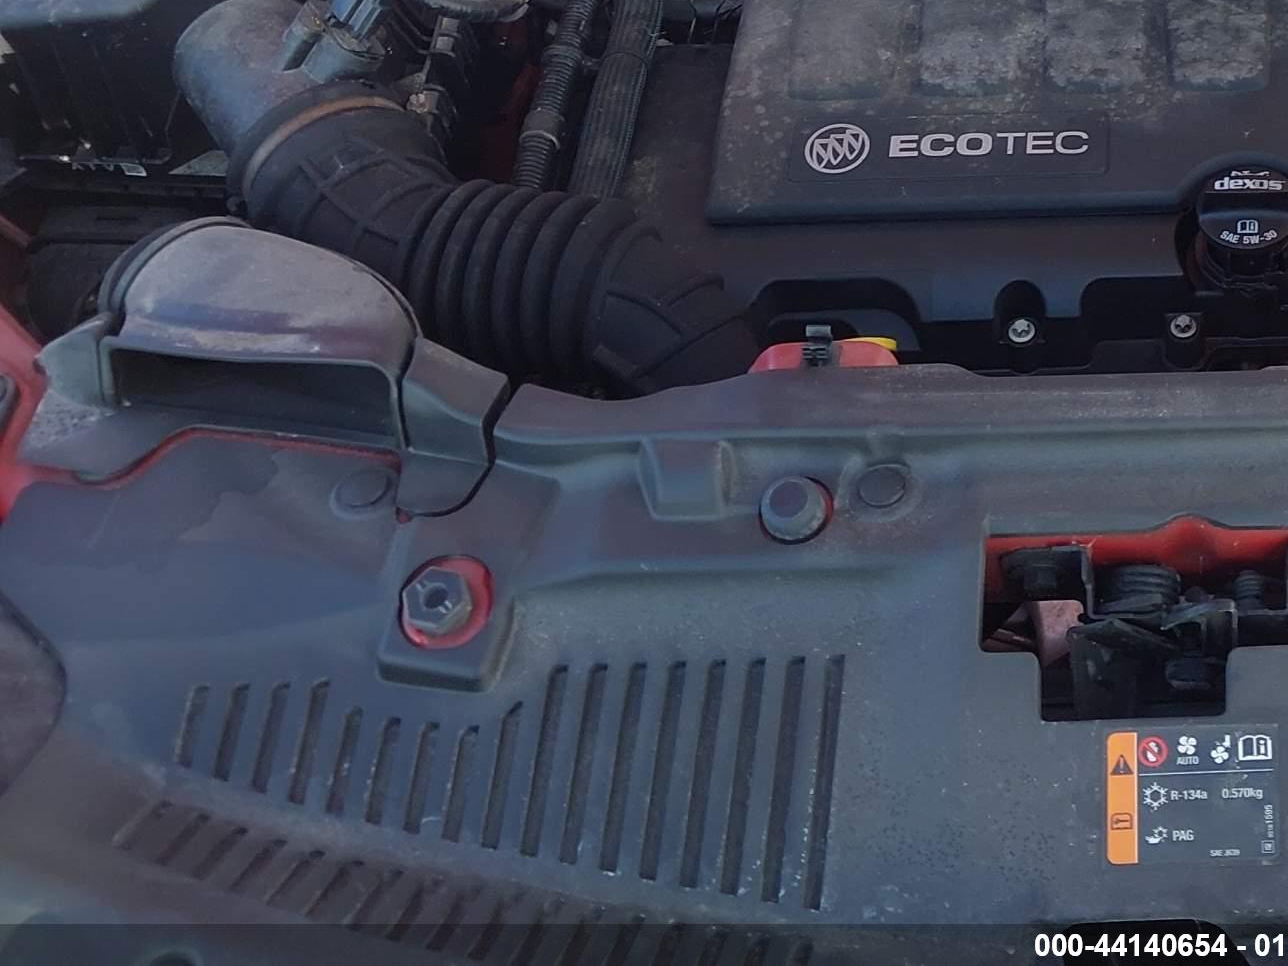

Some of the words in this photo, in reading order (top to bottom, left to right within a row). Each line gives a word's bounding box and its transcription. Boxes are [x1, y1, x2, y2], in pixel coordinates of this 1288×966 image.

[888, 130, 1089, 158] ECOTEC
[1213, 176, 1286, 191] dexos
[1220, 230, 1240, 244] SAE
[1242, 229, 1278, 244] 5W-30
[1176, 755, 1200, 766] AUTO
[1170, 788, 1209, 801] R-134a
[1221, 787, 1264, 800] 0.570kg
[1172, 830, 1195, 842] PAG
